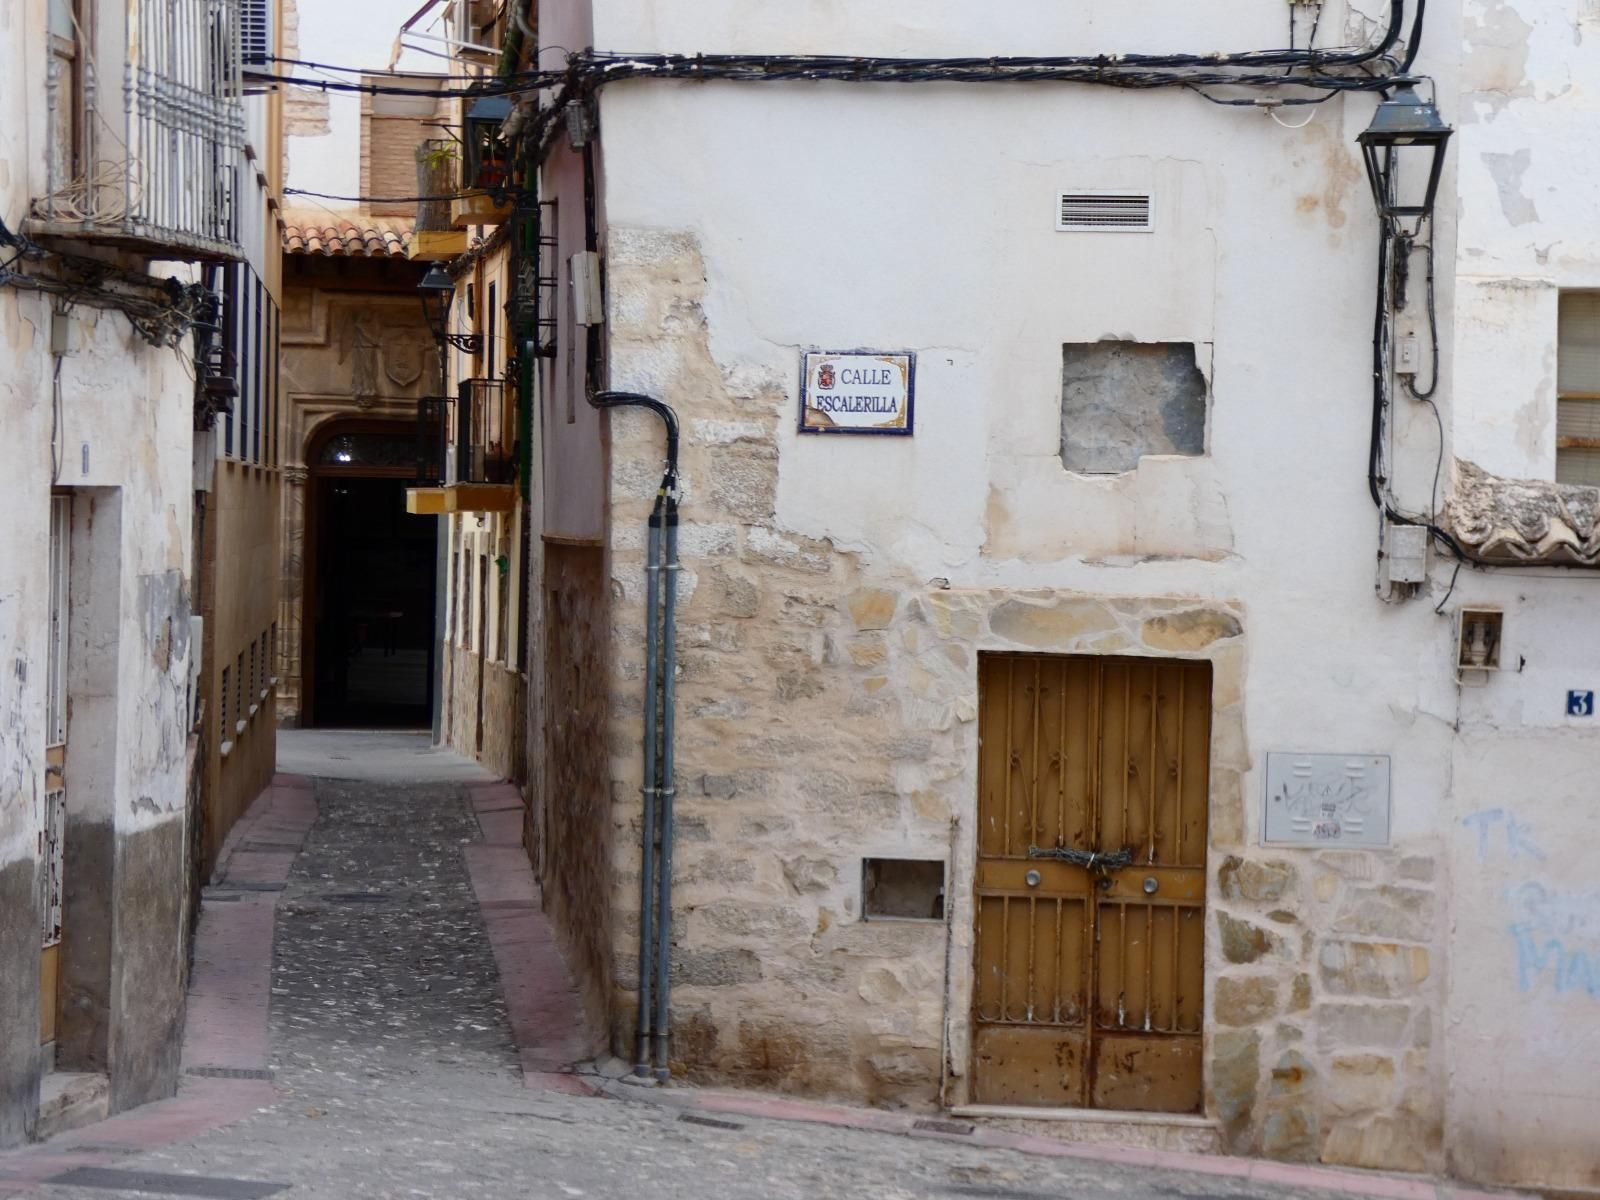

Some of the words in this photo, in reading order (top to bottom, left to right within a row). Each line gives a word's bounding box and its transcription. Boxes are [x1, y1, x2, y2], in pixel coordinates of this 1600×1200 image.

[841, 368, 892, 385] CALLE
[816, 394, 898, 413] ESCALERILLA
[1573, 690, 1588, 716] 3
